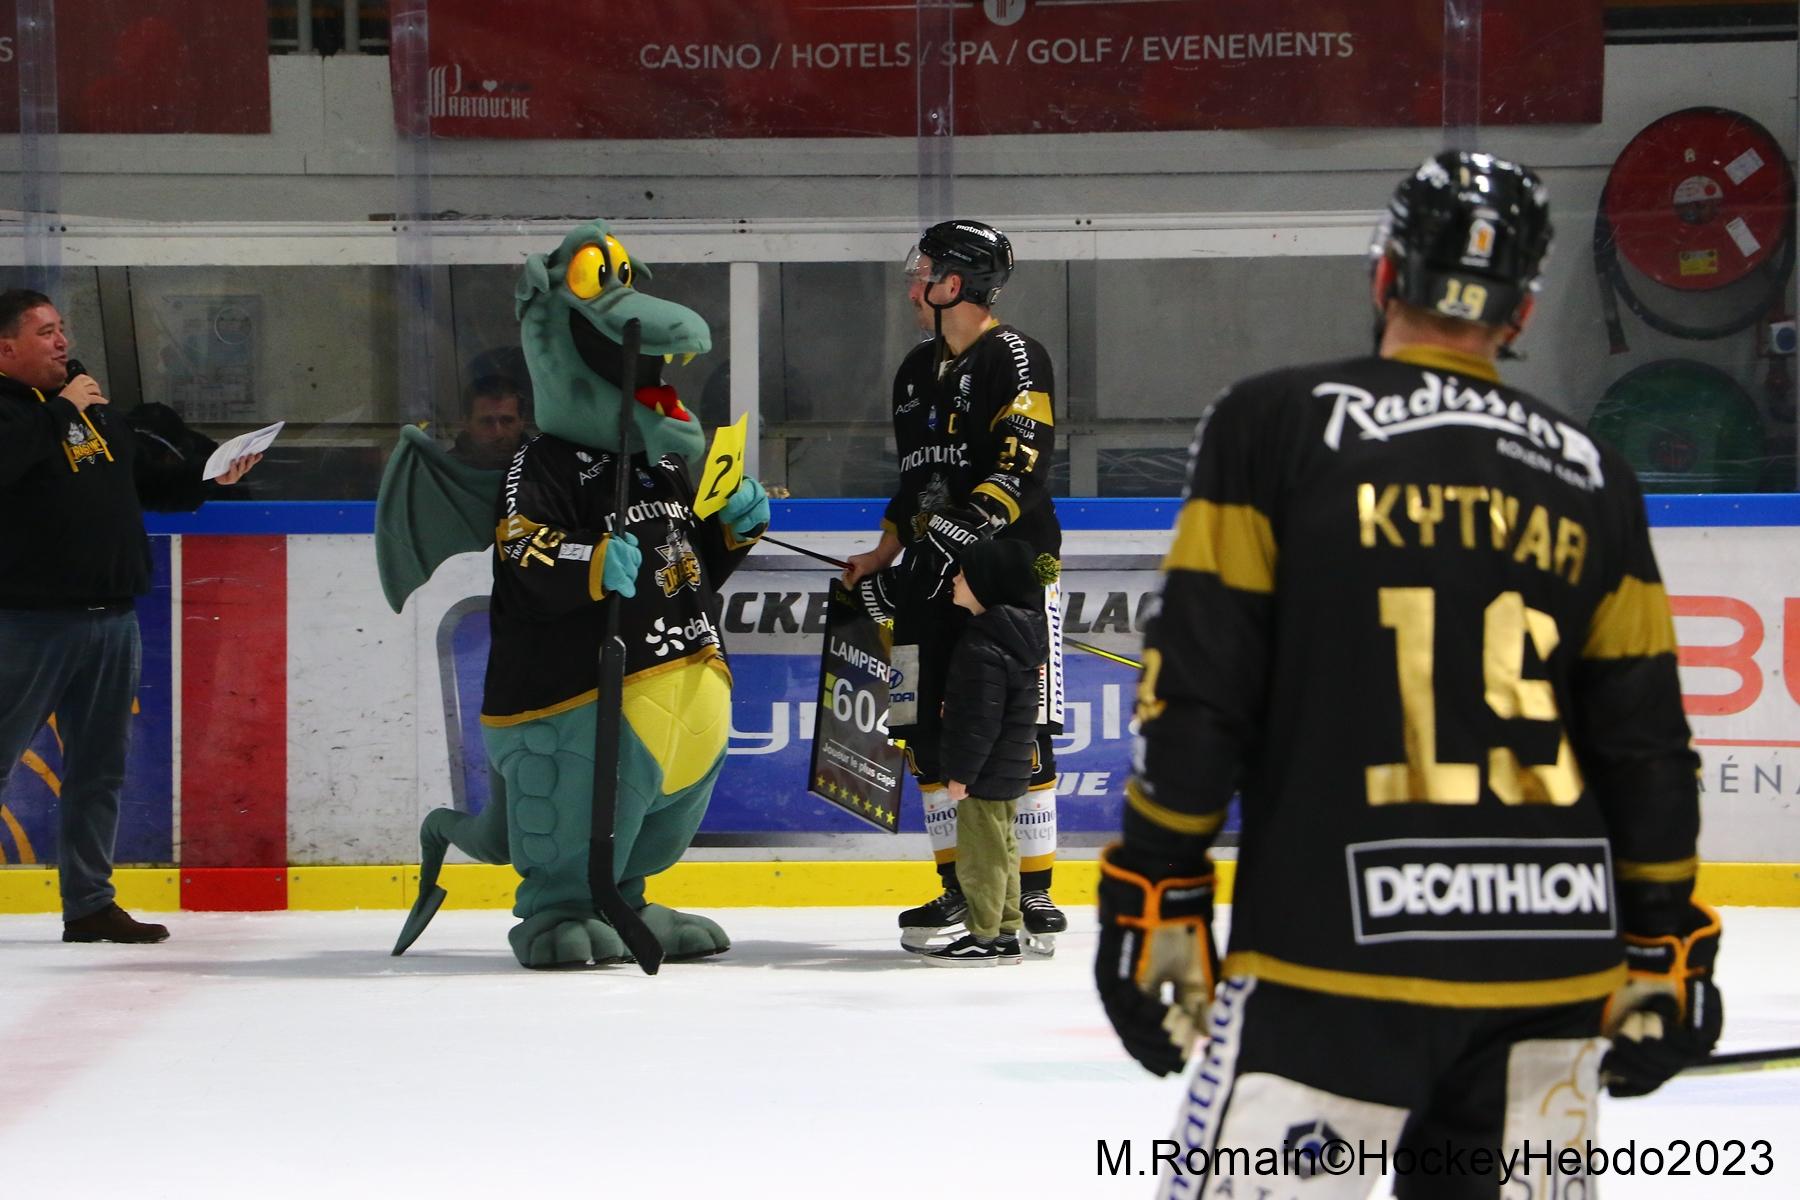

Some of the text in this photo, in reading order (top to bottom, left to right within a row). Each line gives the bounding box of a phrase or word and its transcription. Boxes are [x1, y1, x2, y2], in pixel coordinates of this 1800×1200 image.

[639, 43, 762, 69] CASINO
[792, 42, 911, 68] HOTELS
[939, 40, 1000, 65] SPA
[1027, 37, 1112, 64] GOLF
[1142, 31, 1354, 62] EVENEMENTS
[1437, 278, 1488, 320] 19
[1006, 414, 1037, 430] AILLY
[704, 451, 743, 502] 2
[829, 636, 892, 683] LAMPERI
[822, 742, 850, 764] Joueur
[858, 762, 876, 778] plus
[876, 772, 897, 788] capé
[1364, 862, 1607, 918] DECATHLON
